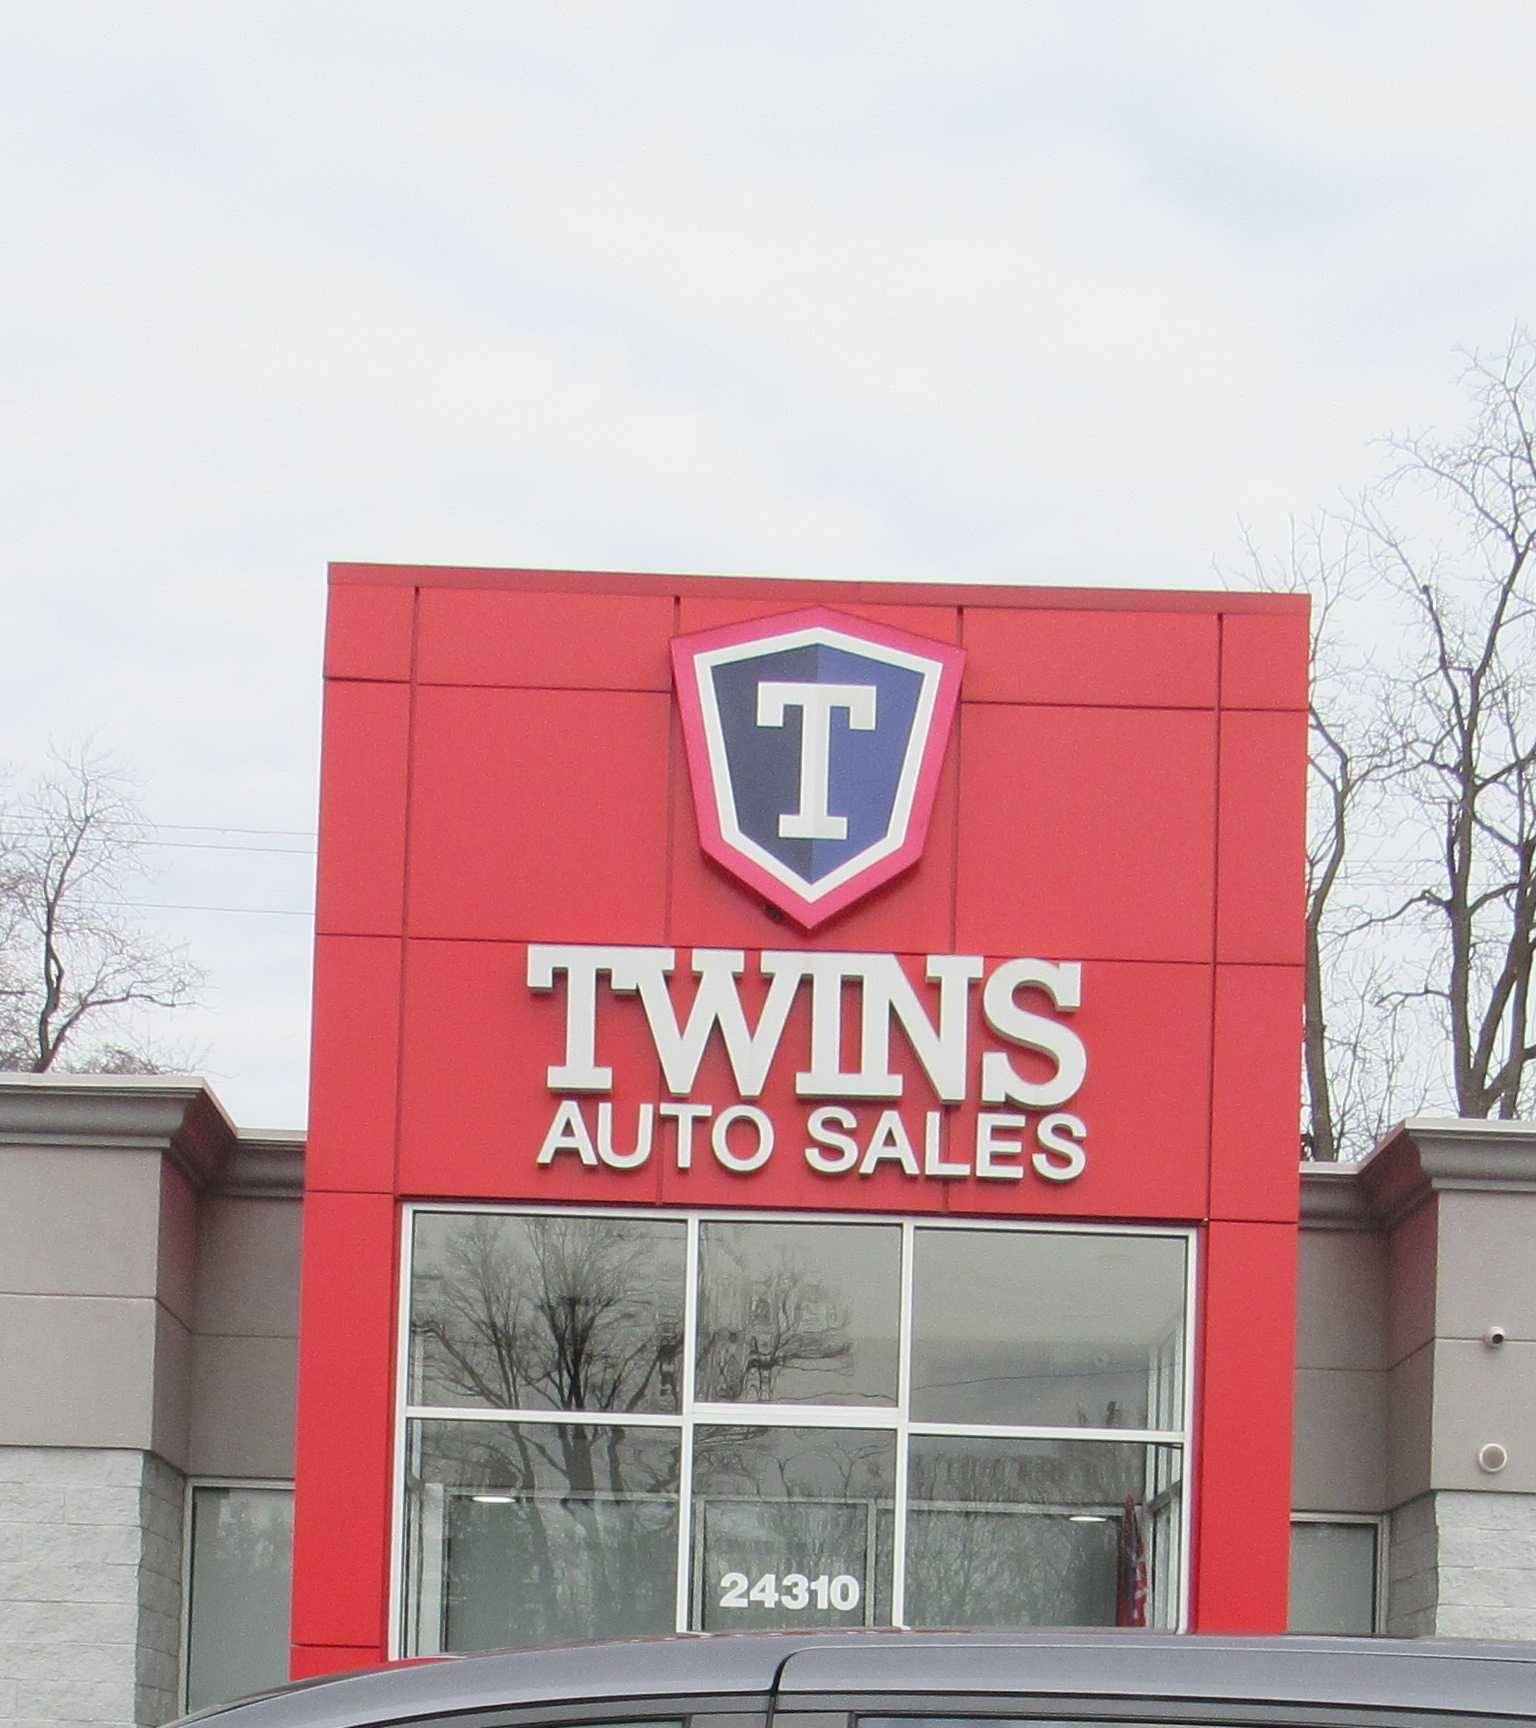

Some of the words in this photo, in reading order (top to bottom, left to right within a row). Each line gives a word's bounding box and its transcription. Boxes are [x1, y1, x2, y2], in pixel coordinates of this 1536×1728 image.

[756, 681, 877, 840] T
[526, 944, 1088, 1109] TWINS
[536, 1100, 776, 1173] AUTO
[804, 1105, 1088, 1183] SALES
[719, 1571, 860, 1611] 24310
